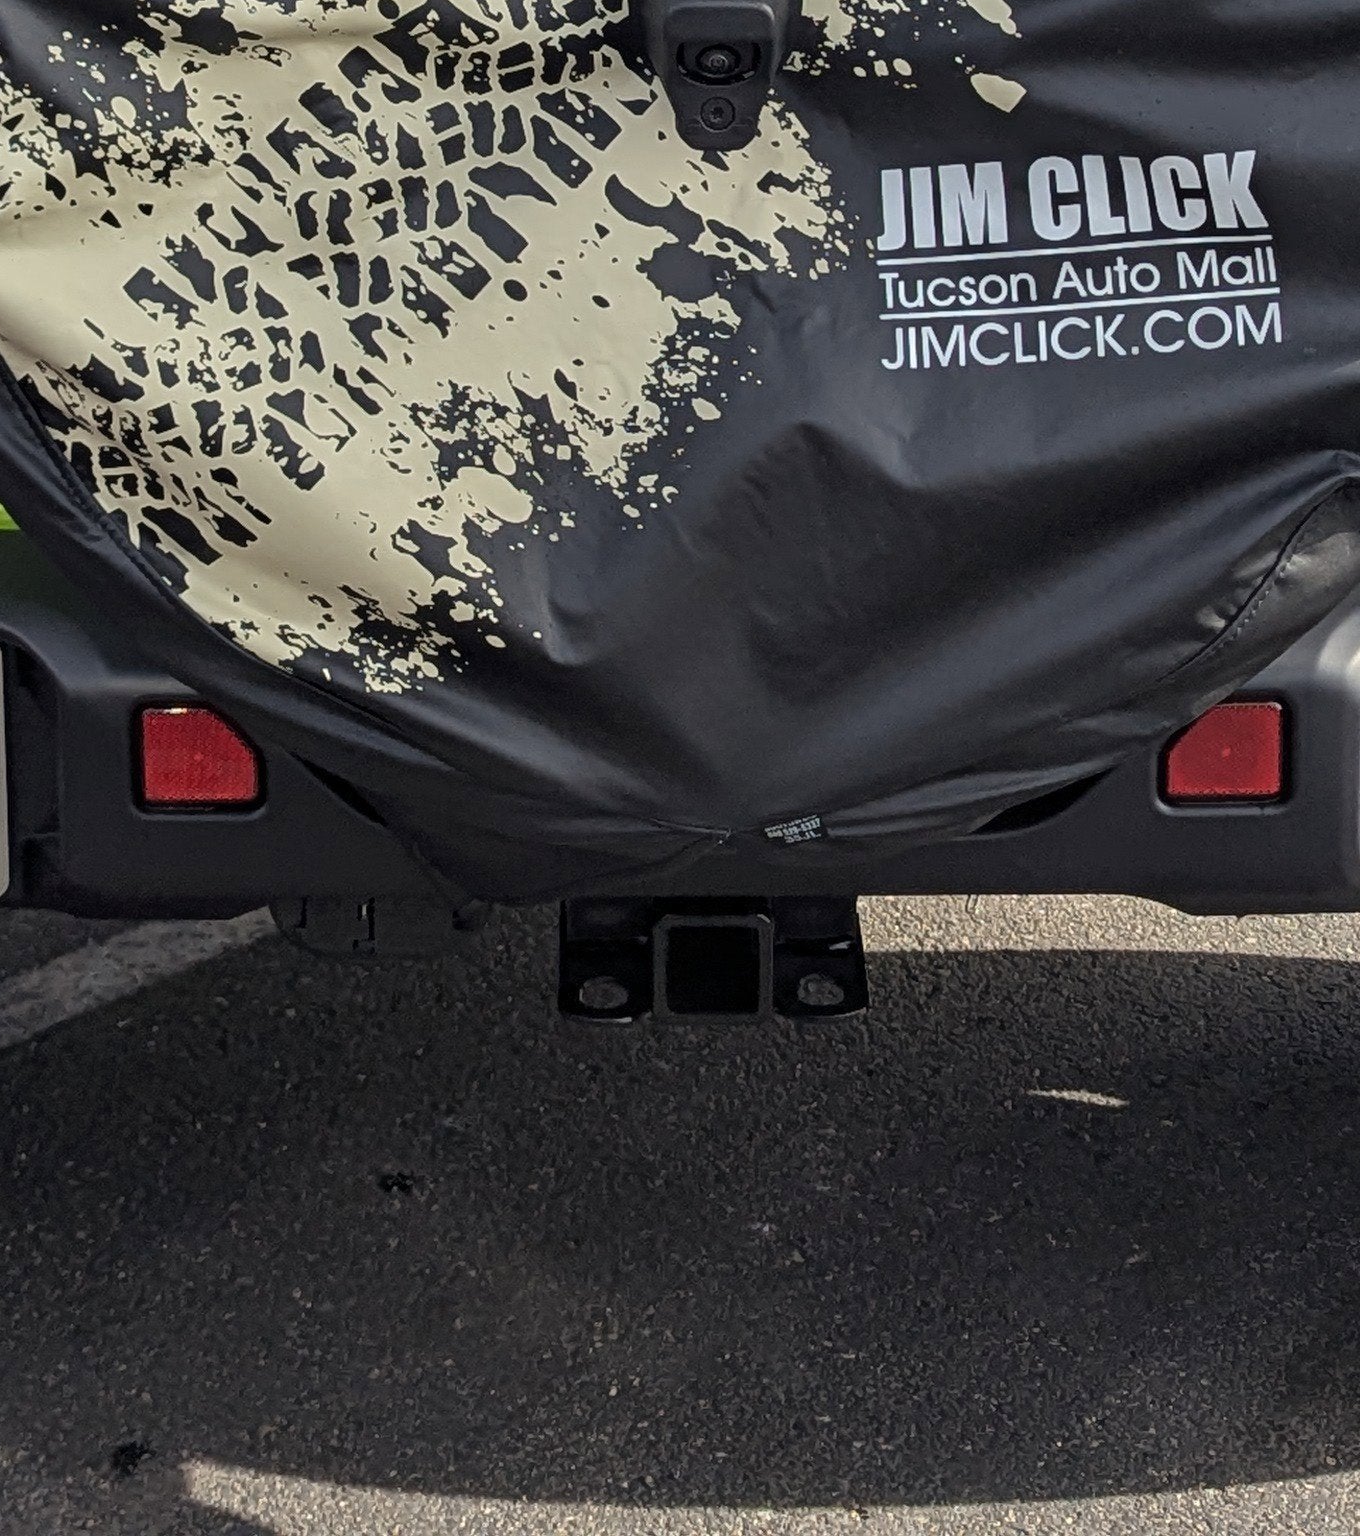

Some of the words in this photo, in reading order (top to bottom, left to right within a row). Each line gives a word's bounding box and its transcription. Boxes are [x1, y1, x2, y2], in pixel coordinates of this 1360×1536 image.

[877, 161, 1008, 251] JIM
[1027, 150, 1269, 241] CLICK
[879, 271, 1037, 309] Tucson
[1052, 256, 1161, 300] Auto
[1176, 246, 1277, 289] Mall
[881, 302, 1283, 370] JIMCLICK.COM
